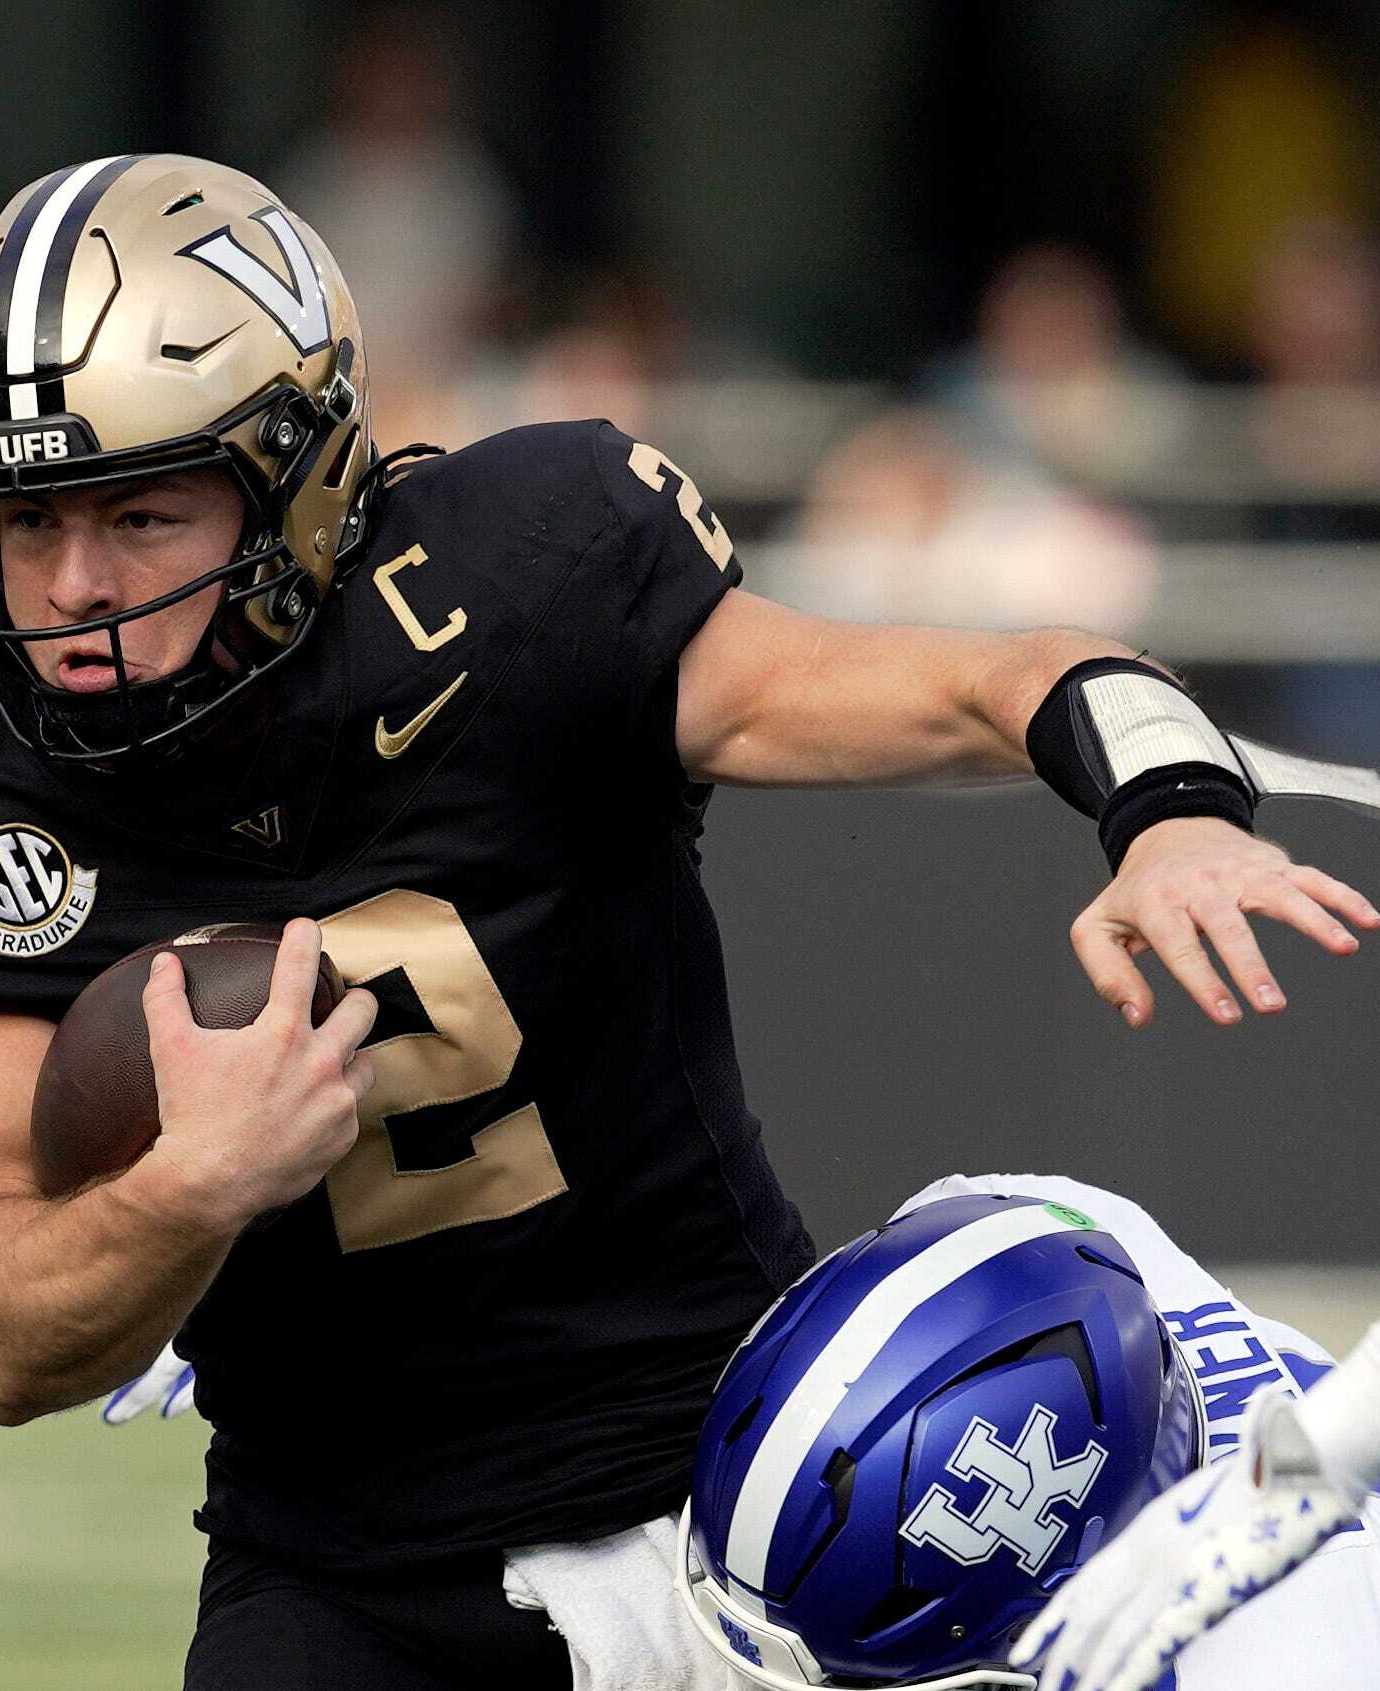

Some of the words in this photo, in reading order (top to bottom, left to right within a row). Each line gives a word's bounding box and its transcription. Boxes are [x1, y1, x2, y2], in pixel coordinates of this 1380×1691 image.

[176, 205, 333, 357] V
[627, 442, 735, 574] 2
[373, 544, 469, 653] C
[311, 888, 569, 1255] 2
[1161, 1301, 1273, 1464] NER
[898, 1403, 1109, 1577] UK
